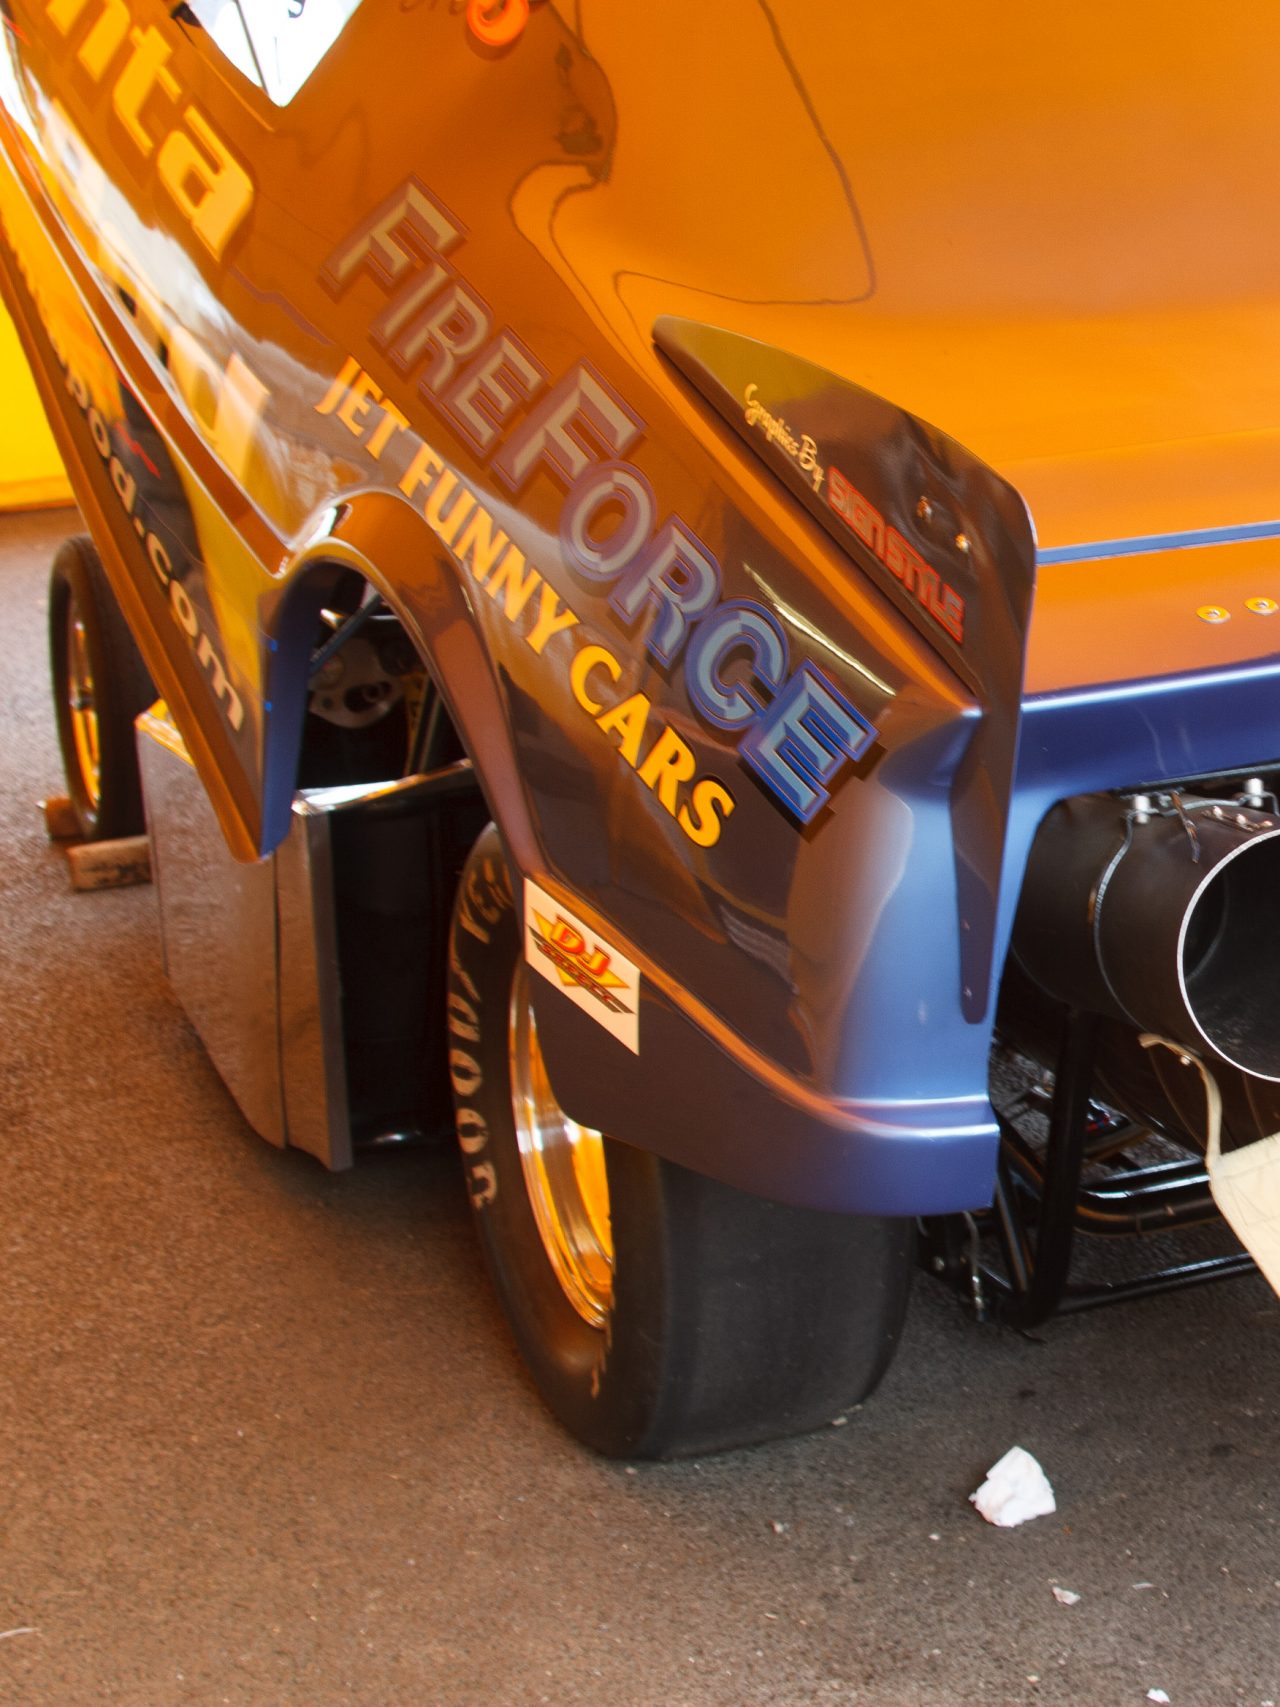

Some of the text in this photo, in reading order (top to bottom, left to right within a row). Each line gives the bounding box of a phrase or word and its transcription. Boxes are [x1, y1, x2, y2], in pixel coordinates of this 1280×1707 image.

[314, 355, 735, 848] JET FUNNY CARS
[551, 914, 611, 976] DJ
